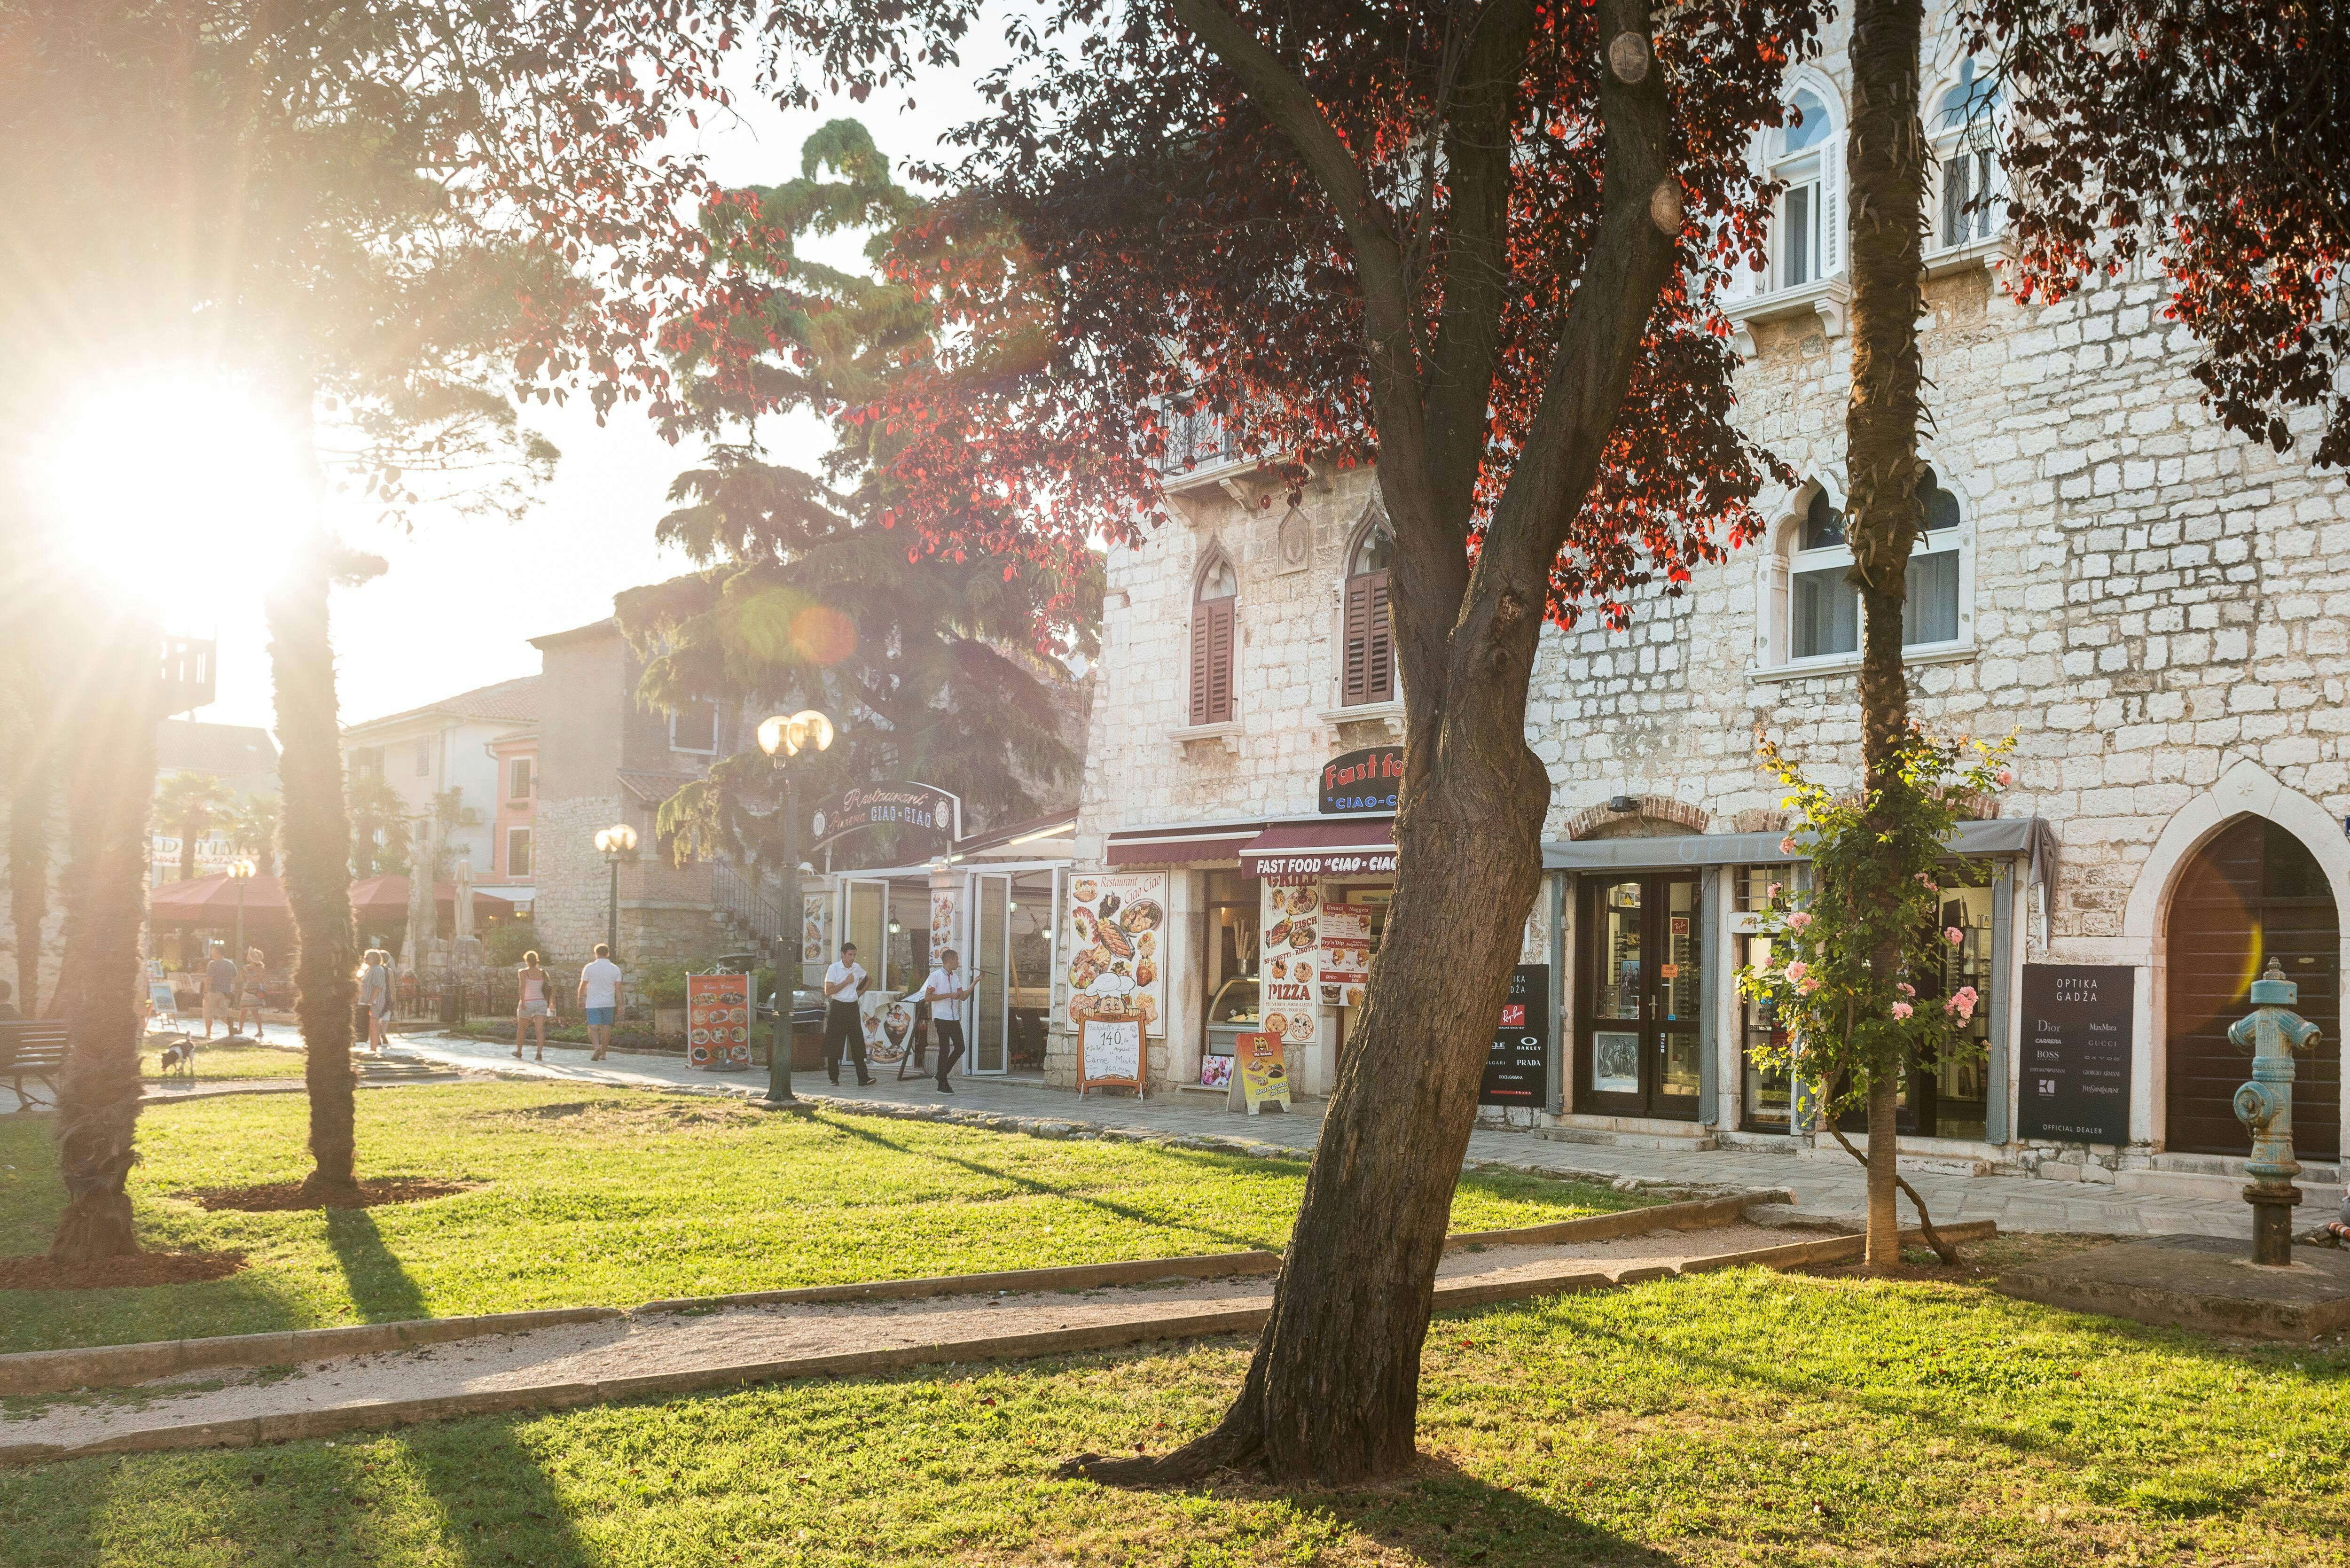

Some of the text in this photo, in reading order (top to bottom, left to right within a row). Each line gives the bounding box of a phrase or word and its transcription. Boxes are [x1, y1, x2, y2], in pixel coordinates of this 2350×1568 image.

[1325, 753, 1403, 790] Fast fo
[844, 788, 929, 811] Restaurant
[1256, 859, 1286, 874] FAST
[1288, 858, 1321, 873] FOOD
[1101, 876, 1138, 888] Restaurant
[1267, 874, 1317, 888] GRILL
[1124, 876, 1161, 904] Ciao Ciao
[1294, 916, 1317, 930] FISCH
[1264, 944, 1318, 964] SPAGHETTI RISOTTO
[1510, 984, 1525, 993] DŽA
[2057, 979, 2098, 989] OPTIKA
[1268, 984, 1311, 1000] PIZZA
[2057, 991, 2097, 1002] GADŽA
[2038, 1020, 2061, 1032] Dior
